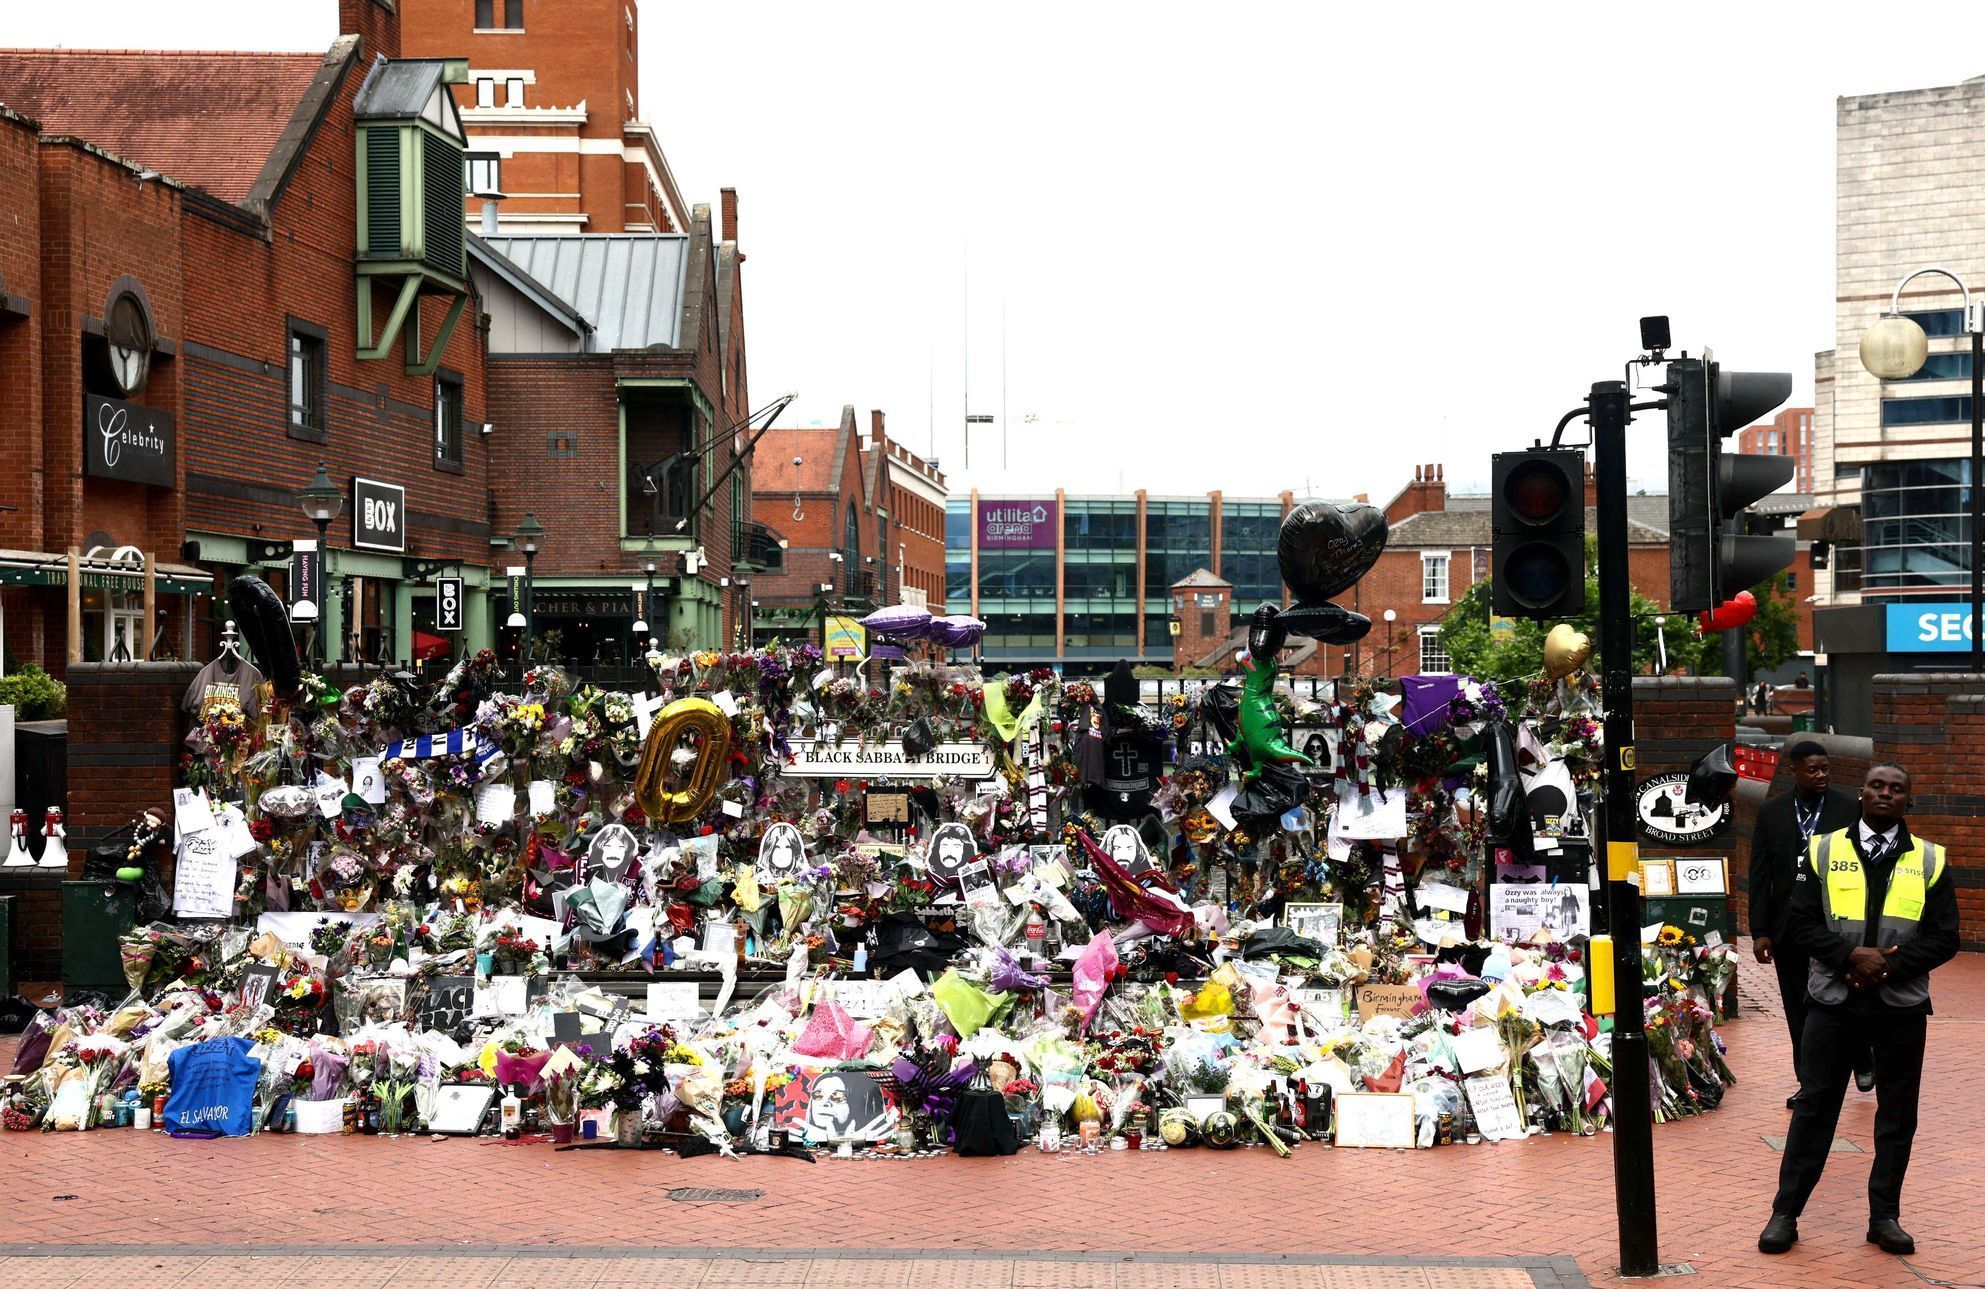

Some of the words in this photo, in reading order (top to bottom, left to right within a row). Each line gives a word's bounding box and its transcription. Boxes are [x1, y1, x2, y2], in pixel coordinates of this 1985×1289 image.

[98, 402, 164, 467] Celebrity
[364, 497, 396, 533] BOX
[986, 508, 1031, 522] utilita
[986, 523, 1032, 535] arena
[47, 571, 98, 588] TRADONAL
[101, 575, 119, 589] FREE
[122, 577, 145, 590] HOUSE
[442, 583, 457, 625] BOX
[536, 602, 581, 613] CHER
[585, 602, 596, 614] &
[602, 602, 629, 613] PIA
[805, 751, 853, 763] BLACK
[926, 752, 981, 764] BRIDGE
[984, 755, 990, 764] 1
[1638, 773, 1690, 794] CANALSID
[1645, 825, 1676, 841] BROAD
[1679, 827, 1714, 842] STREET
[1830, 860, 1859, 872] 385
[1504, 889, 1522, 898] Ozzy
[1540, 888, 1564, 898] always
[1510, 896, 1539, 904] naughty
[1540, 896, 1557, 904] boy!
[913, 905, 955, 916] Sabbath
[1362, 990, 1422, 1006] Birmingham
[1375, 1003, 1401, 1014] Forever
[180, 1109, 191, 1124] EL
